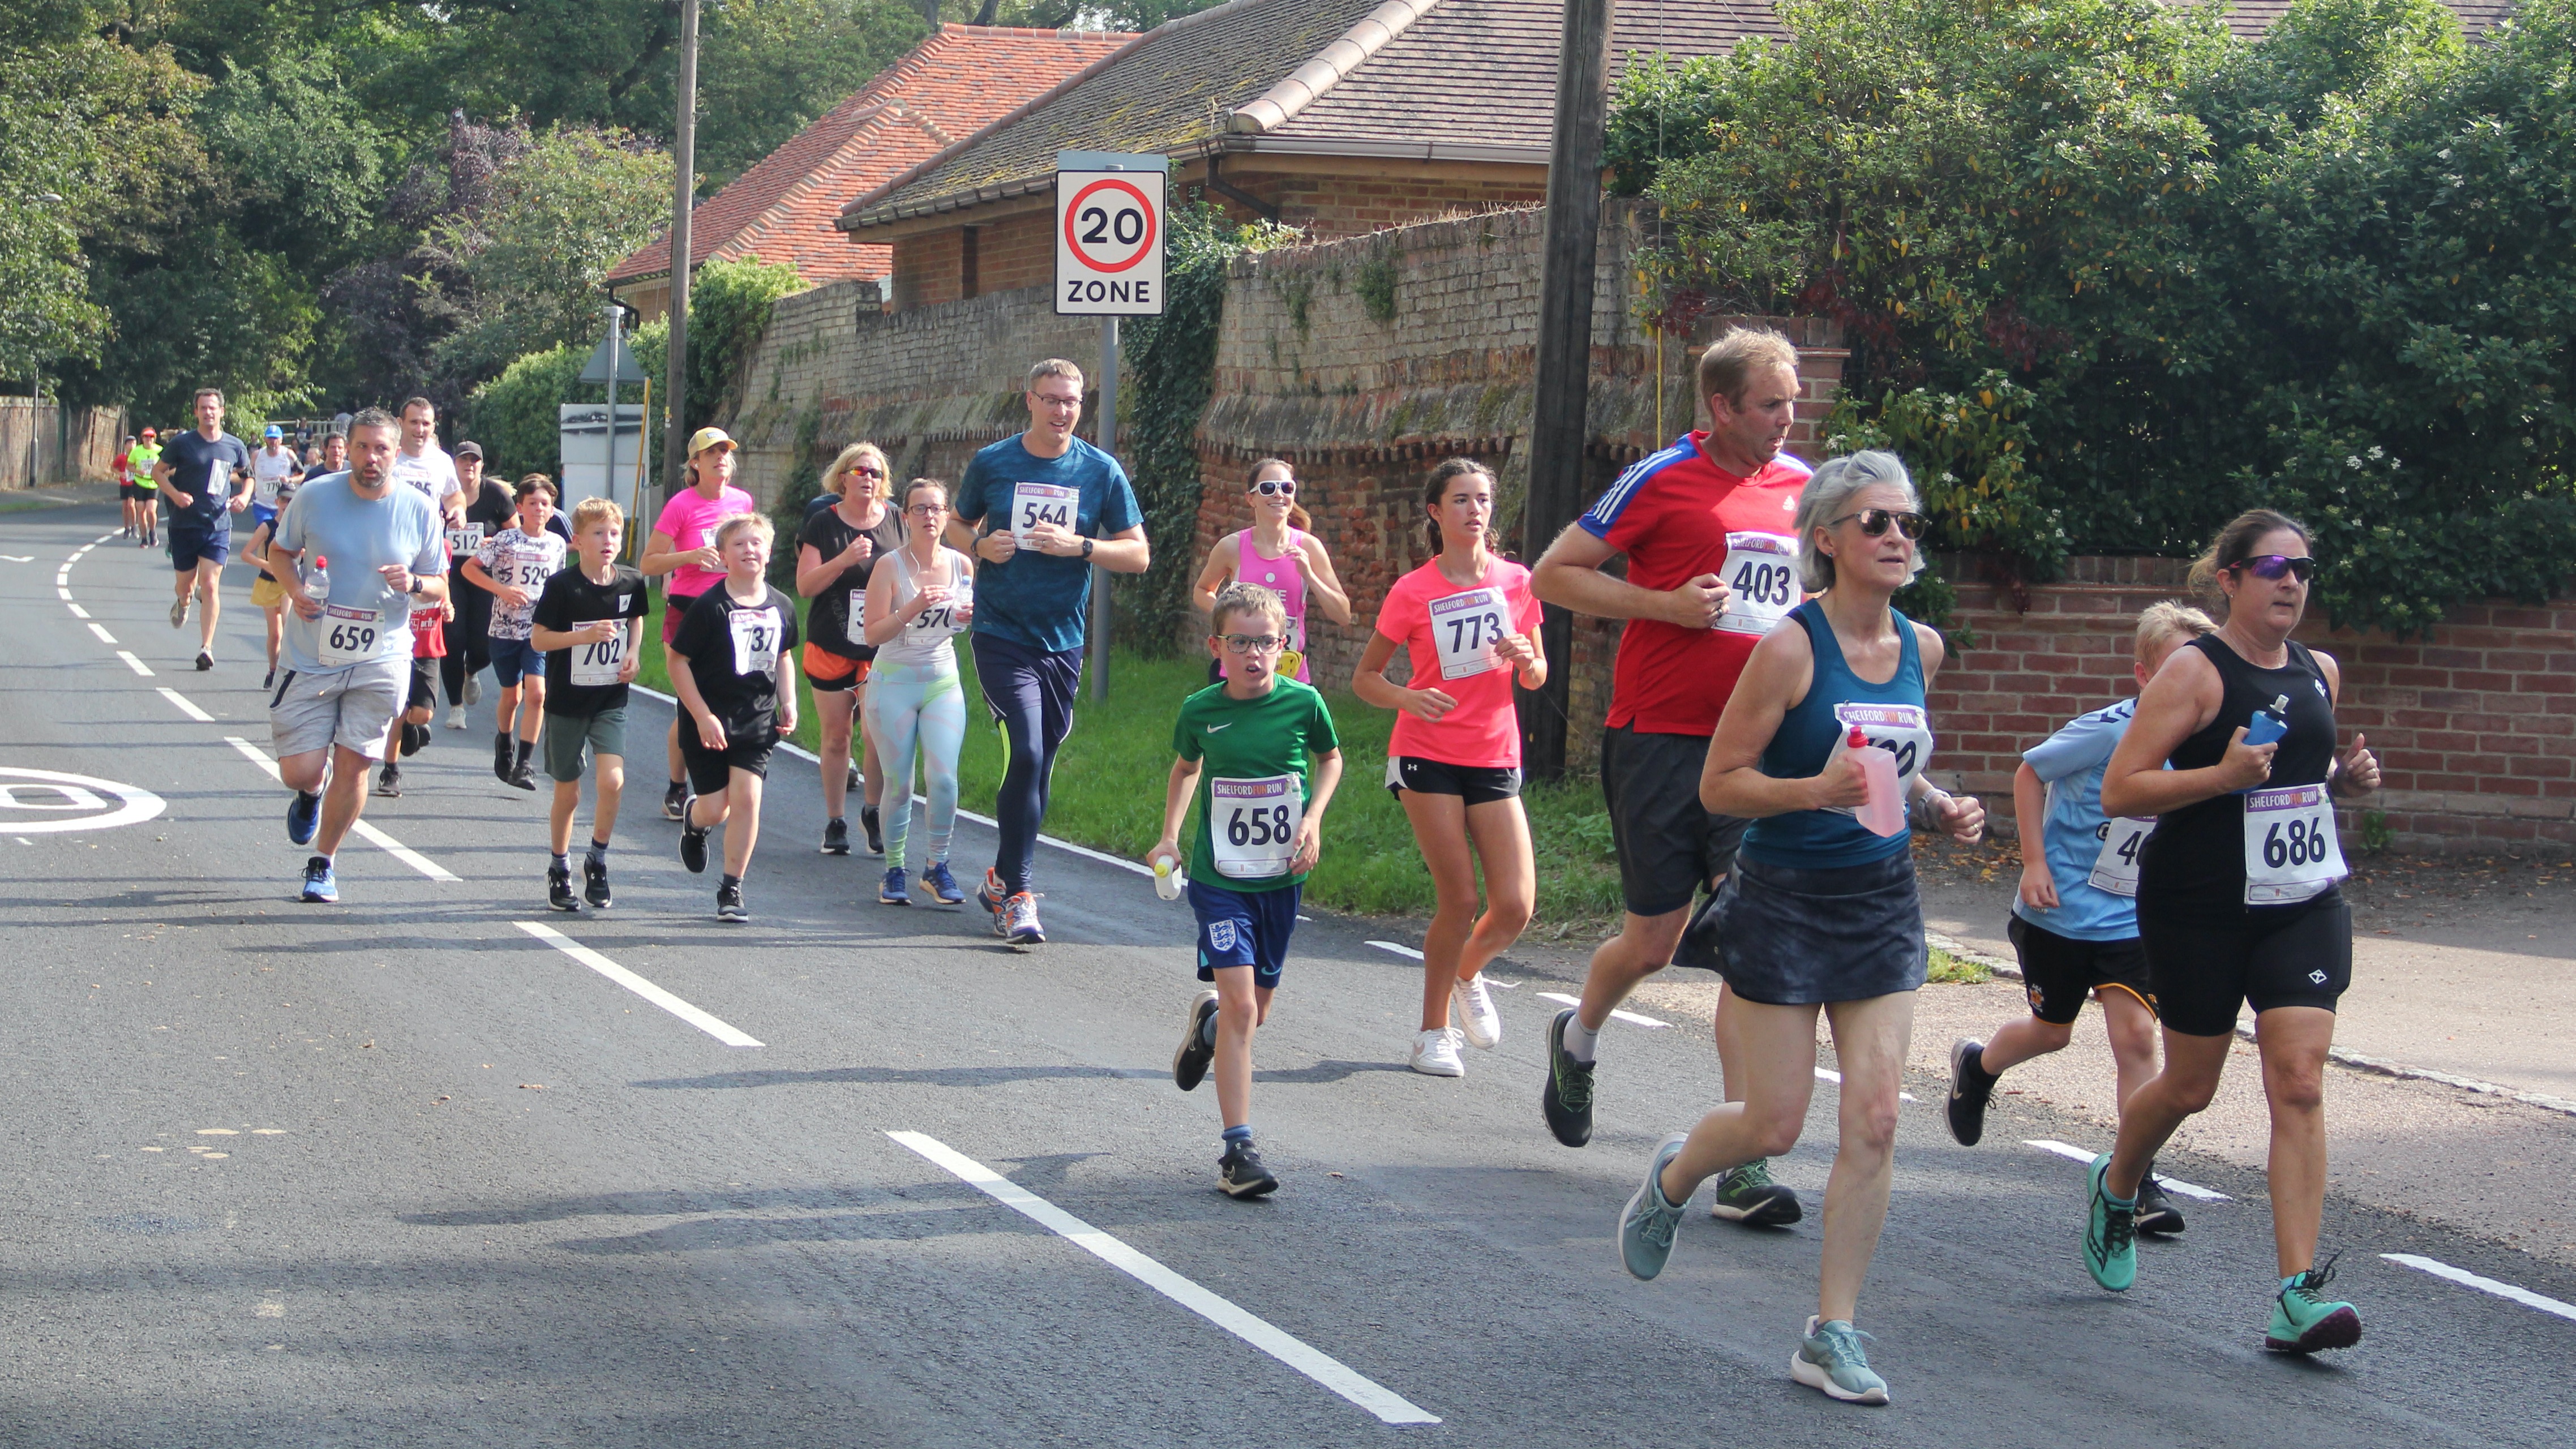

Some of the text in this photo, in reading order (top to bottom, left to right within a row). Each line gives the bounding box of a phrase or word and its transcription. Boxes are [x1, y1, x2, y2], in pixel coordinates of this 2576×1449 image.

[1081, 207, 1143, 245] 20
[1068, 280, 1150, 303] ZONE
[1019, 486, 1064, 497] SHELFORDFUNRUN
[1022, 502, 1068, 528] 564
[453, 534, 478, 550] 512
[1733, 537, 1788, 552] SHELFORDFUNRUN
[520, 566, 550, 585] 529
[1732, 561, 1790, 606] 403
[328, 607, 372, 620] SHELFORDFUNRUN
[1434, 594, 1489, 613] SHELFORDFUNRUN
[330, 624, 375, 652] 659
[743, 627, 775, 653] 737
[1447, 612, 1504, 653] 773
[584, 637, 620, 665] 702
[1844, 710, 1914, 724] SHELFORDFUNRUN
[1217, 783, 1282, 795] SHELFORDFUNRUN
[2249, 791, 2317, 808] SHELFORDFUNRUN
[1228, 805, 1291, 846] 658
[2264, 817, 2326, 868] 686
